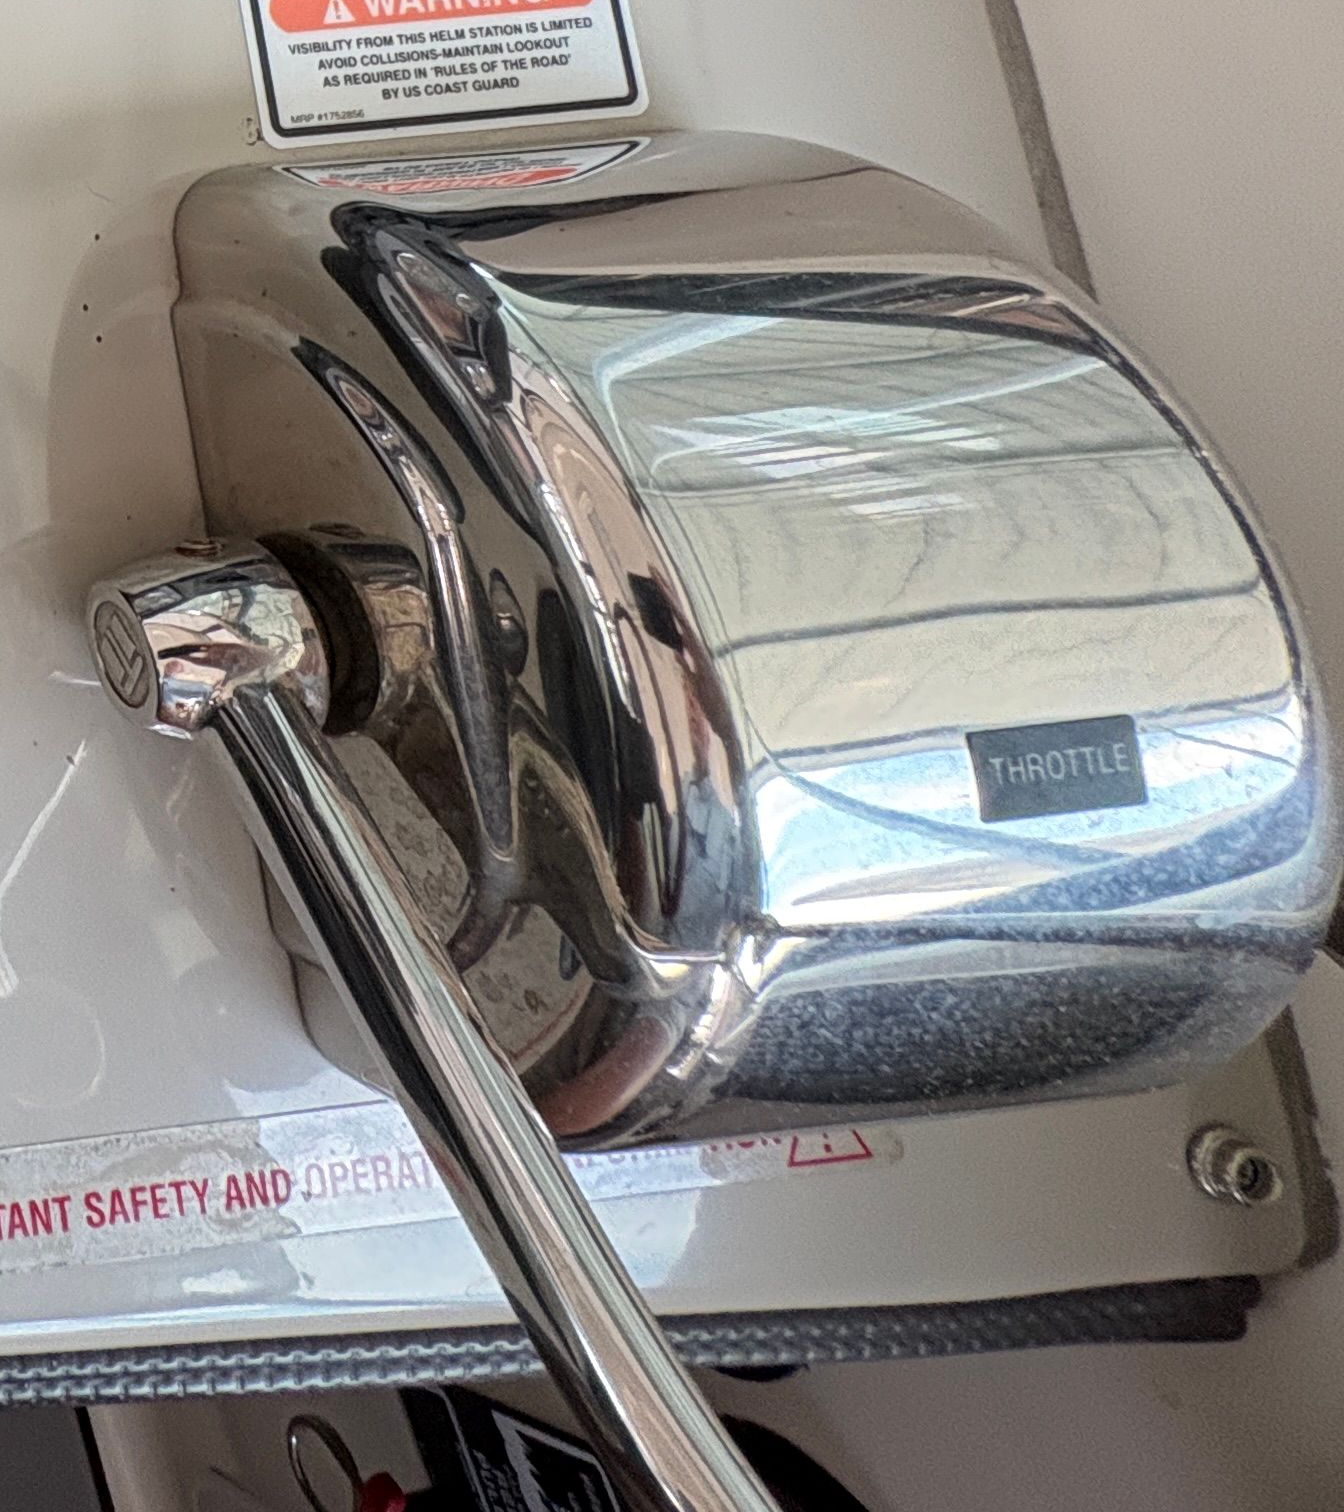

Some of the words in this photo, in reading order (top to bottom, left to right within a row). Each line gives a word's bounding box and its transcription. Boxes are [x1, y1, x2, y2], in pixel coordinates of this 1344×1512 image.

[288, 37, 353, 56] VISIBILITY
[356, 35, 394, 49] FROM
[397, 32, 427, 46] THIS
[429, 28, 467, 43] HELM
[468, 23, 524, 39] STATION
[525, 21, 539, 34] IS
[541, 16, 593, 32] LIMITED
[318, 56, 358, 71] AVOID
[506, 36, 571, 54] LOOKOUT
[322, 75, 341, 89] AS
[343, 69, 412, 87] REQUIRED
[414, 66, 428, 80] IN
[481, 61, 499, 74] OF
[502, 57, 528, 71] THE
[381, 87, 400, 101] BY
[402, 85, 422, 99] US
[424, 80, 469, 97] COAST
[472, 76, 520, 91] GUARD
[988, 741, 1131, 786] THROTTLE
[83, 1178, 210, 1230] SAFETY
[224, 1167, 292, 1213] AND
[302, 1148, 434, 1202] OPERAT
